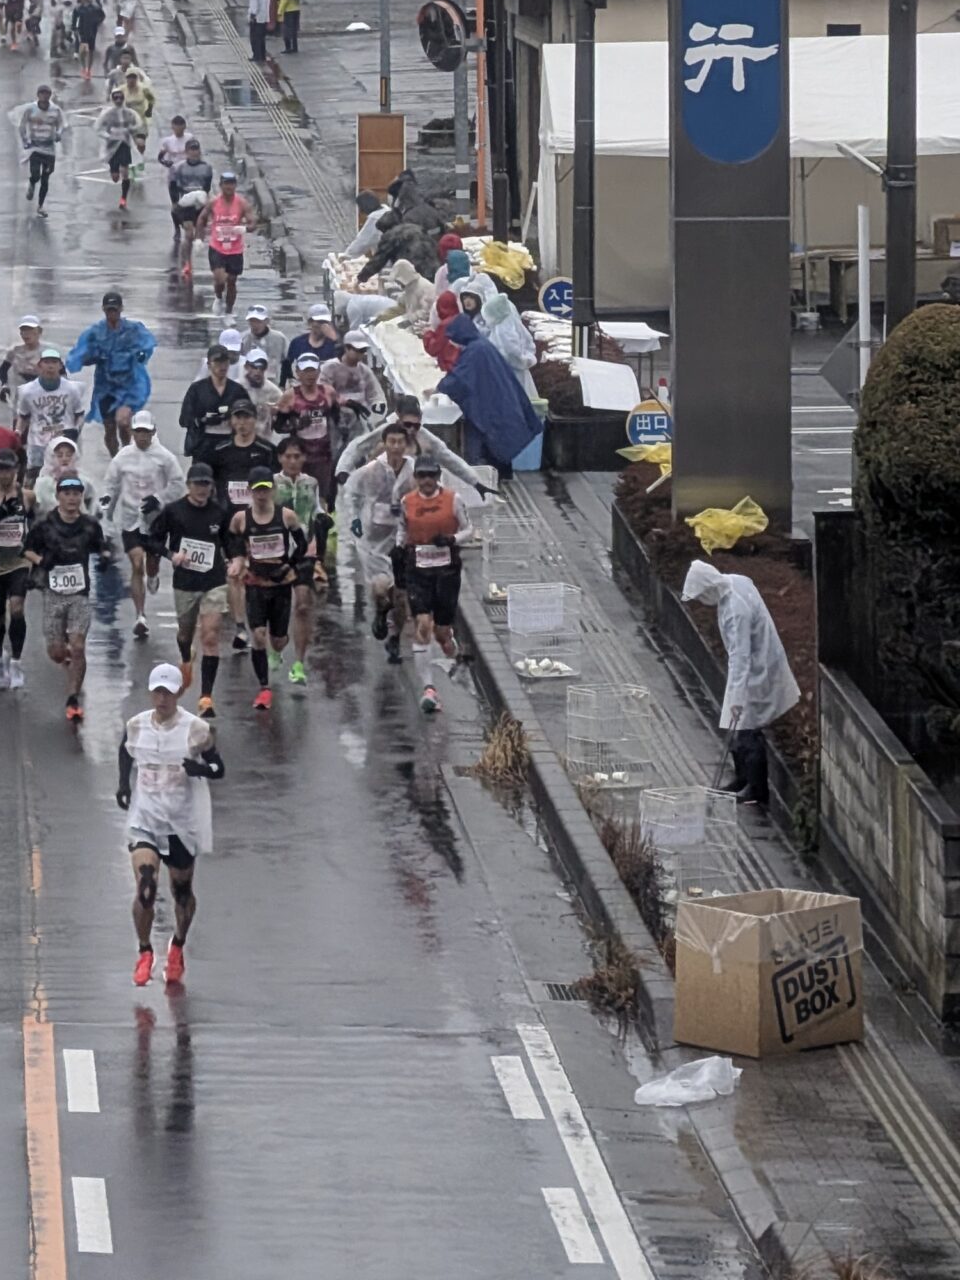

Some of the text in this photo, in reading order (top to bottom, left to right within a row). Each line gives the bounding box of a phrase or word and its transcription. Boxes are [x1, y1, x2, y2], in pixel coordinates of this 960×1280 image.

[548, 288, 573, 300] 入口
[636, 415, 668, 431] 出口
[783, 951, 839, 1003] DUST
[794, 980, 840, 1025] BOX
